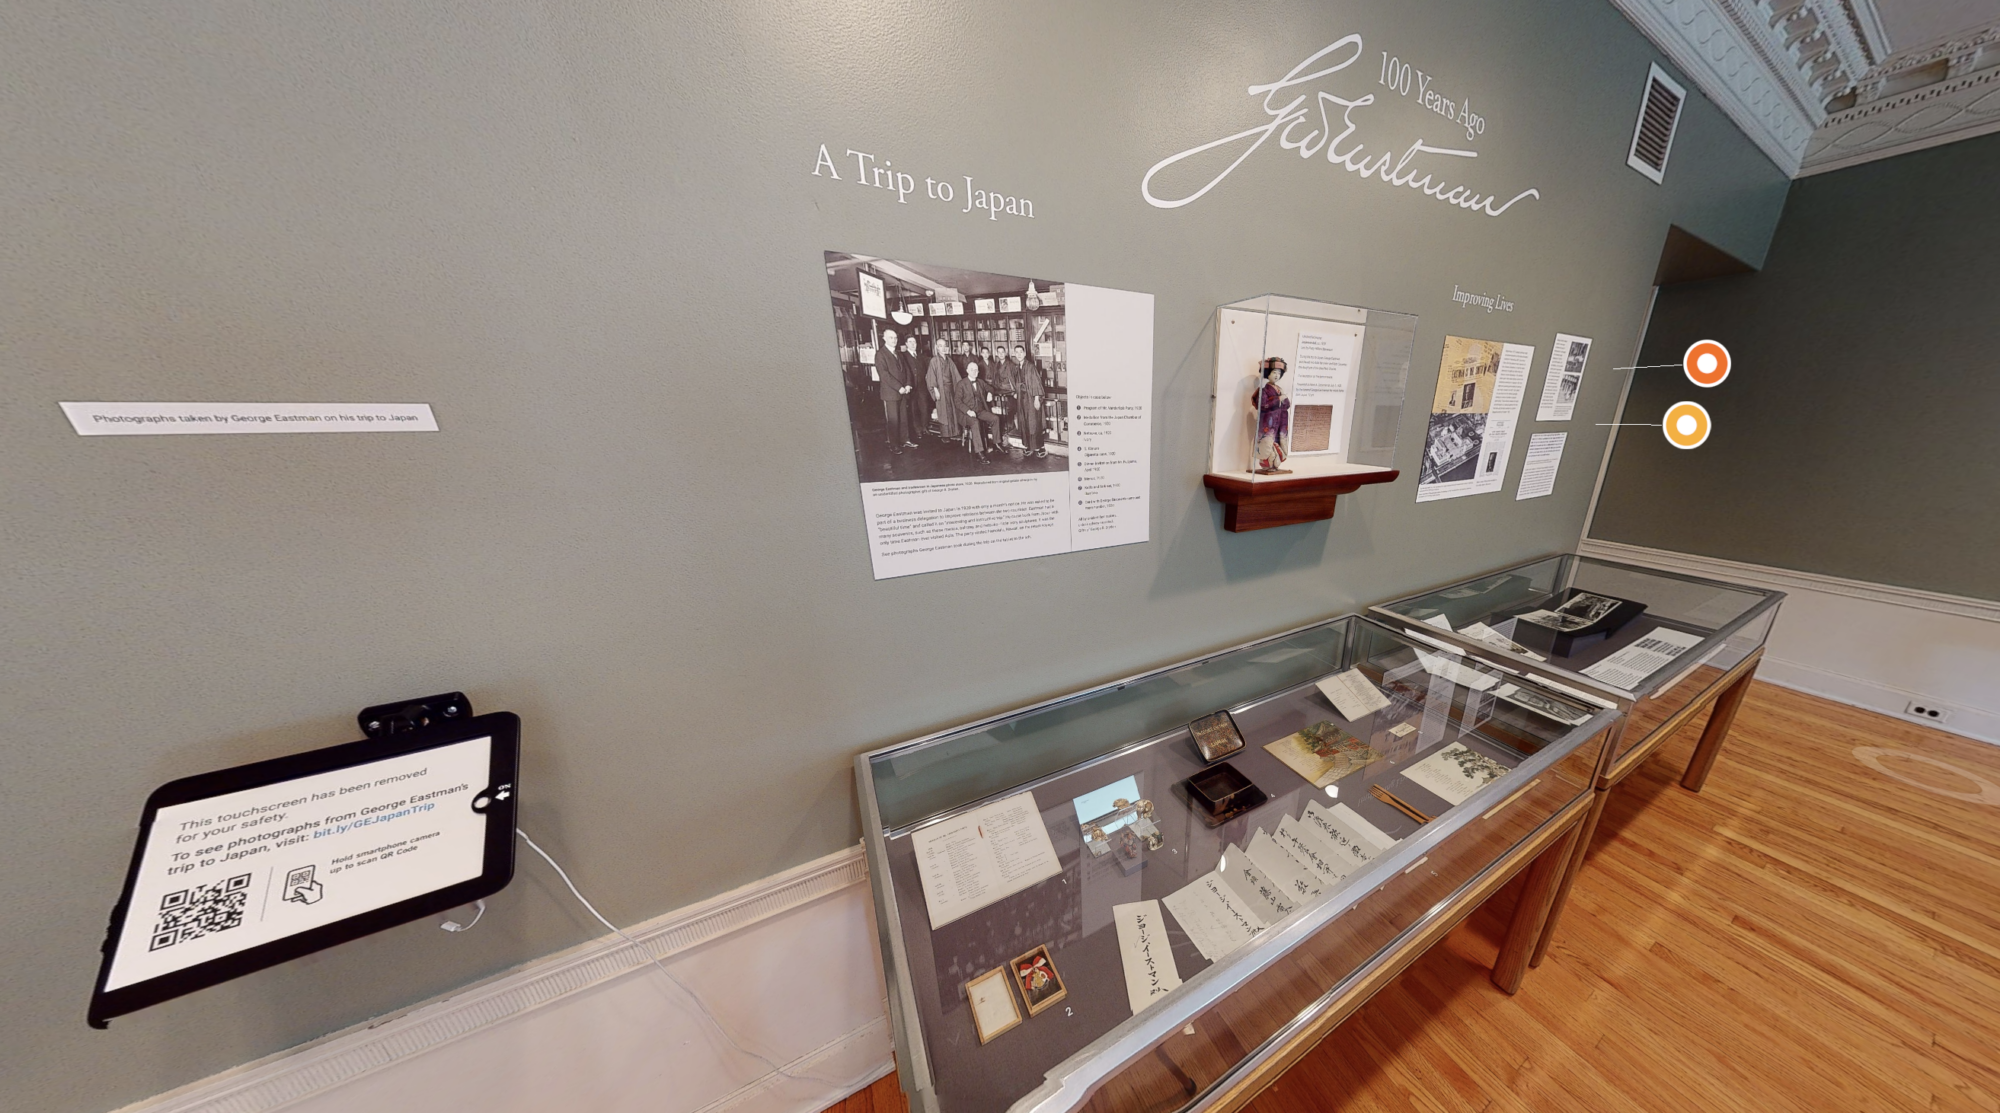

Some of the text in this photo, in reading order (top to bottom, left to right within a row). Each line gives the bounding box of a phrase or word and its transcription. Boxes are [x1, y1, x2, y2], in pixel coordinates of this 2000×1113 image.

[1378, 51, 1486, 140] 100 Years Ago
[812, 143, 1035, 221] A Trip to Japan
[1452, 284, 1514, 313] Improving Lives
[92, 414, 176, 425] Photographs
[178, 414, 212, 423] taken
[214, 414, 229, 424] by
[231, 414, 273, 424] George
[274, 414, 323, 423] Eastman
[339, 414, 355, 422] his
[357, 414, 374, 423] trip
[388, 414, 418, 423] Japan
[180, 768, 428, 831] This touchscreen has been removed
[167, 801, 435, 876] trip to Japan, visit: bit.ly/GEJapanTrip
[172, 783, 469, 862] To see photographs from George Eastman's
[176, 812, 289, 844] for your safety.
[329, 866, 342, 874] up
[357, 856, 378, 867] scan
[380, 851, 394, 860] QR
[396, 845, 418, 855] Code
[331, 831, 440, 865] Hold smartphone camera
[1065, 1006, 1074, 1017] 2
